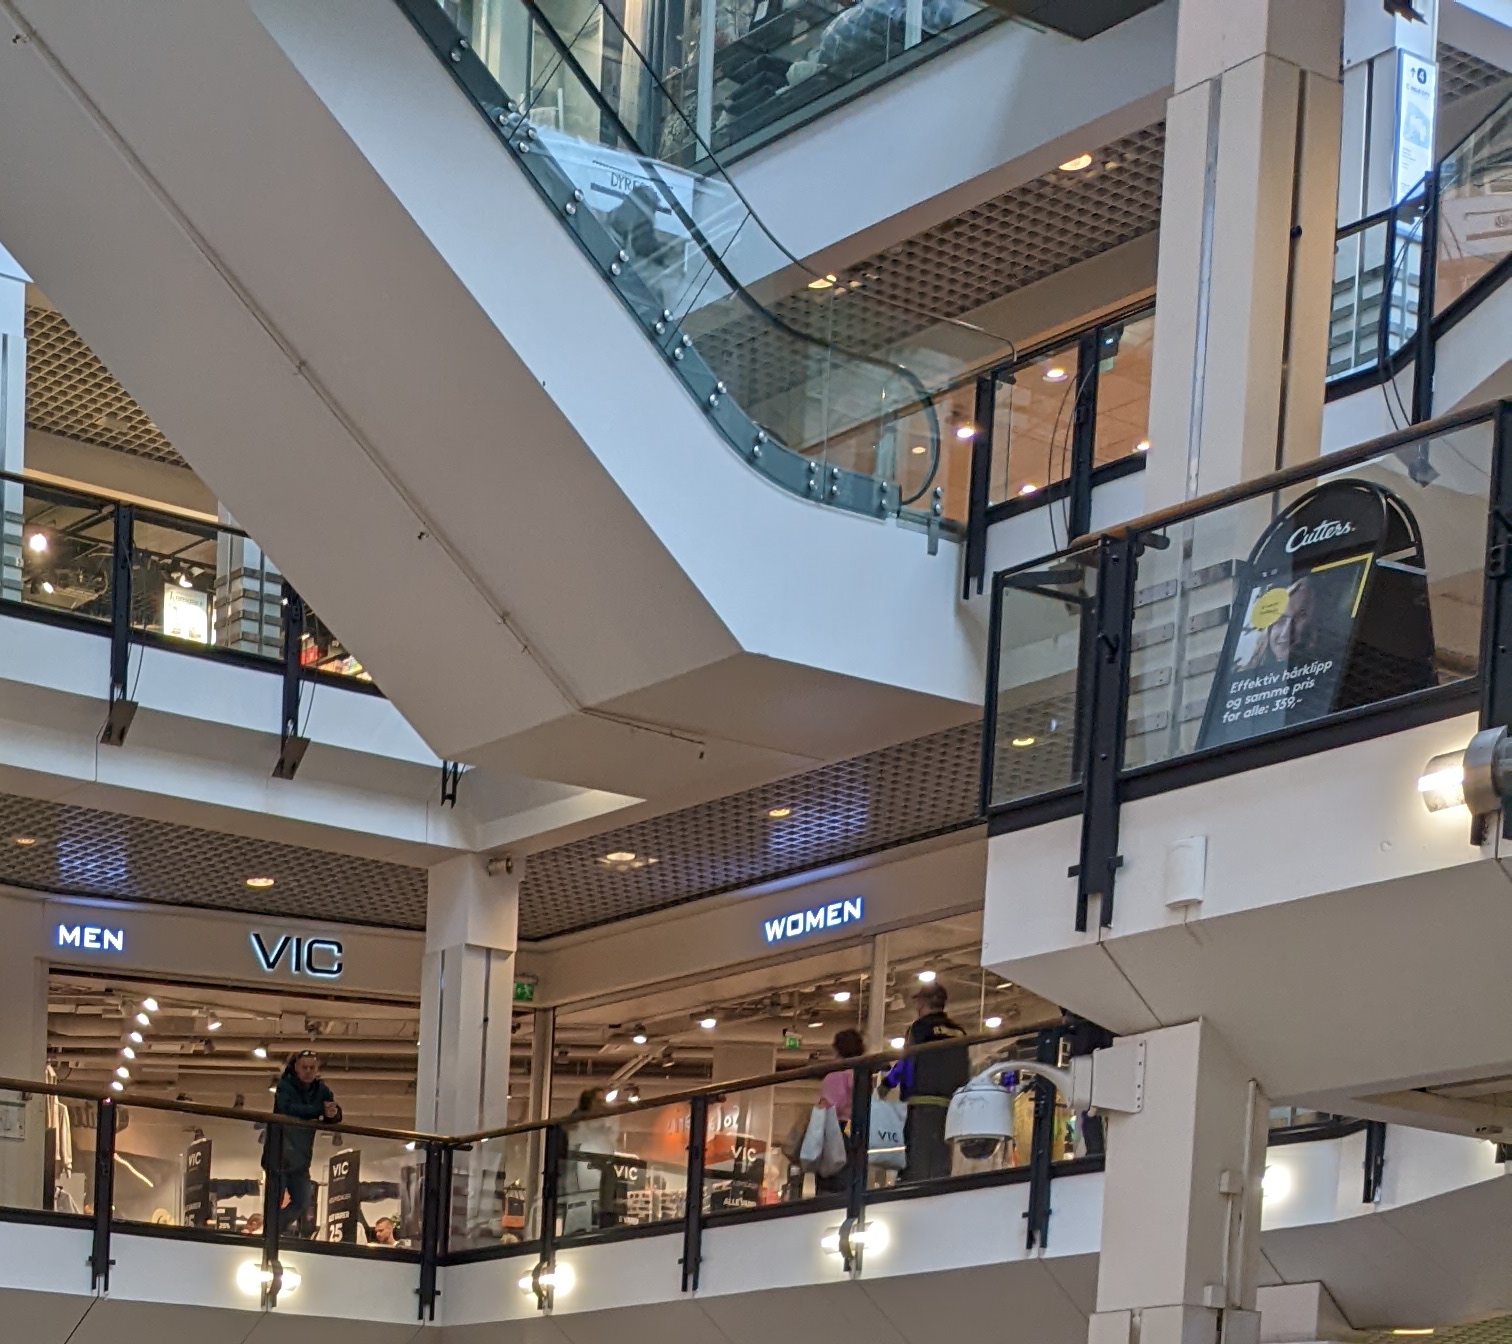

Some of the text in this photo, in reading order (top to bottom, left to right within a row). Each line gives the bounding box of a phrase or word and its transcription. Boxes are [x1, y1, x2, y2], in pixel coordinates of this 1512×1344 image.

[1230, 659, 1333, 694] Effektiv hårklipp
[1226, 677, 1316, 711] og samme pris
[1223, 707, 1240, 723] for
[764, 897, 863, 943] WOMEN
[58, 924, 124, 951] MEN
[251, 932, 343, 977] VIC
[731, 1146, 757, 1163] VIC
[333, 1161, 349, 1177] VIC
[614, 1165, 639, 1181] VIC
